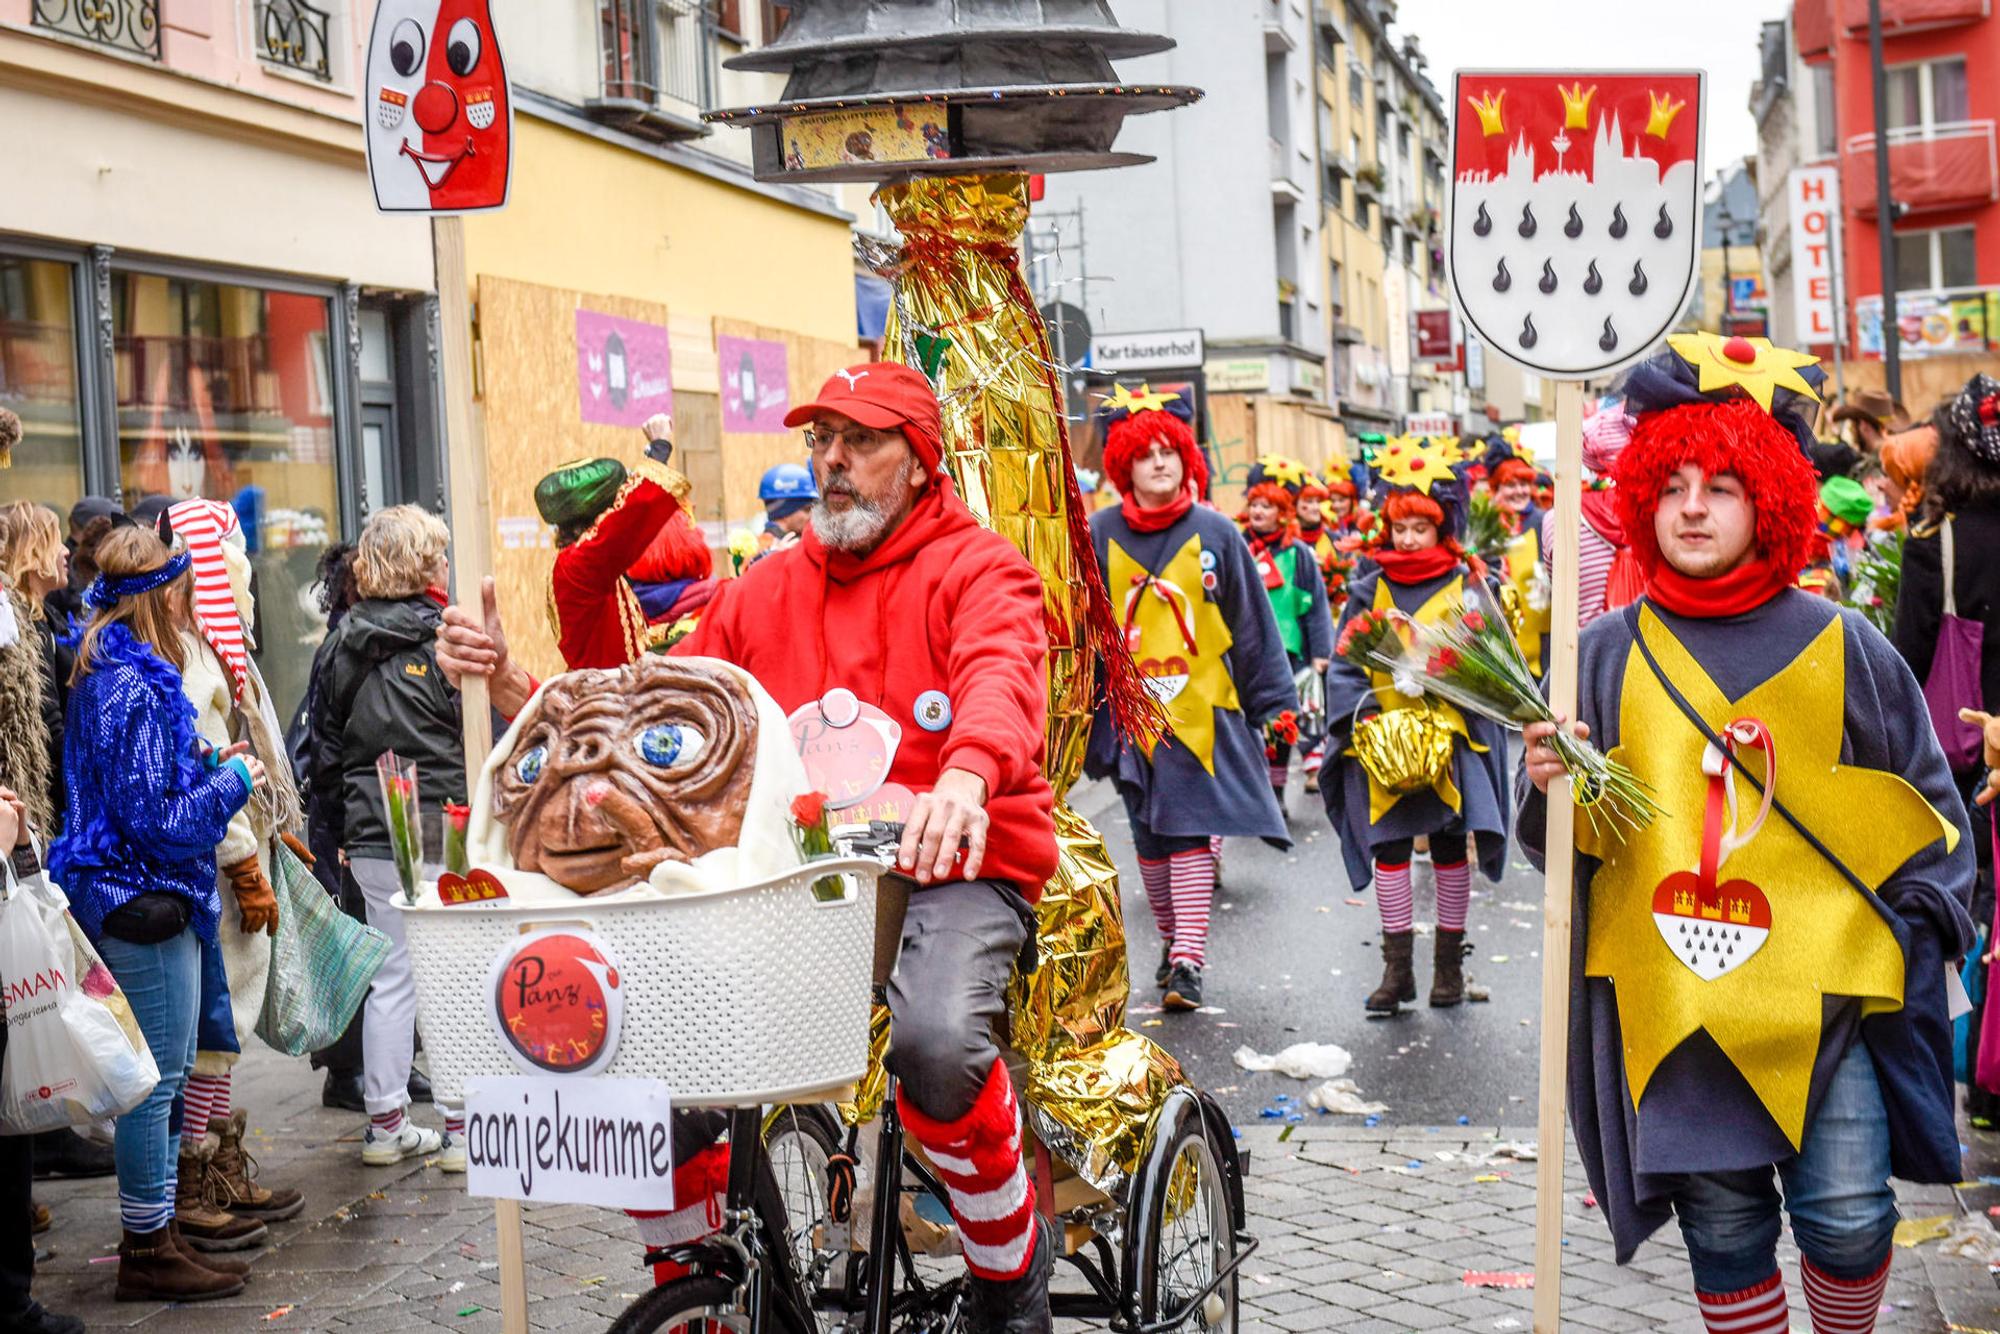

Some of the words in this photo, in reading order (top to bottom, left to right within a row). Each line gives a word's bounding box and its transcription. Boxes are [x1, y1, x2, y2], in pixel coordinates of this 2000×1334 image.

[1801, 178, 1833, 334] HOTEL
[1097, 340, 1196, 361] Kartäuserhof
[513, 955, 582, 1009] Panz
[468, 1089, 670, 1197] aanjekumme
